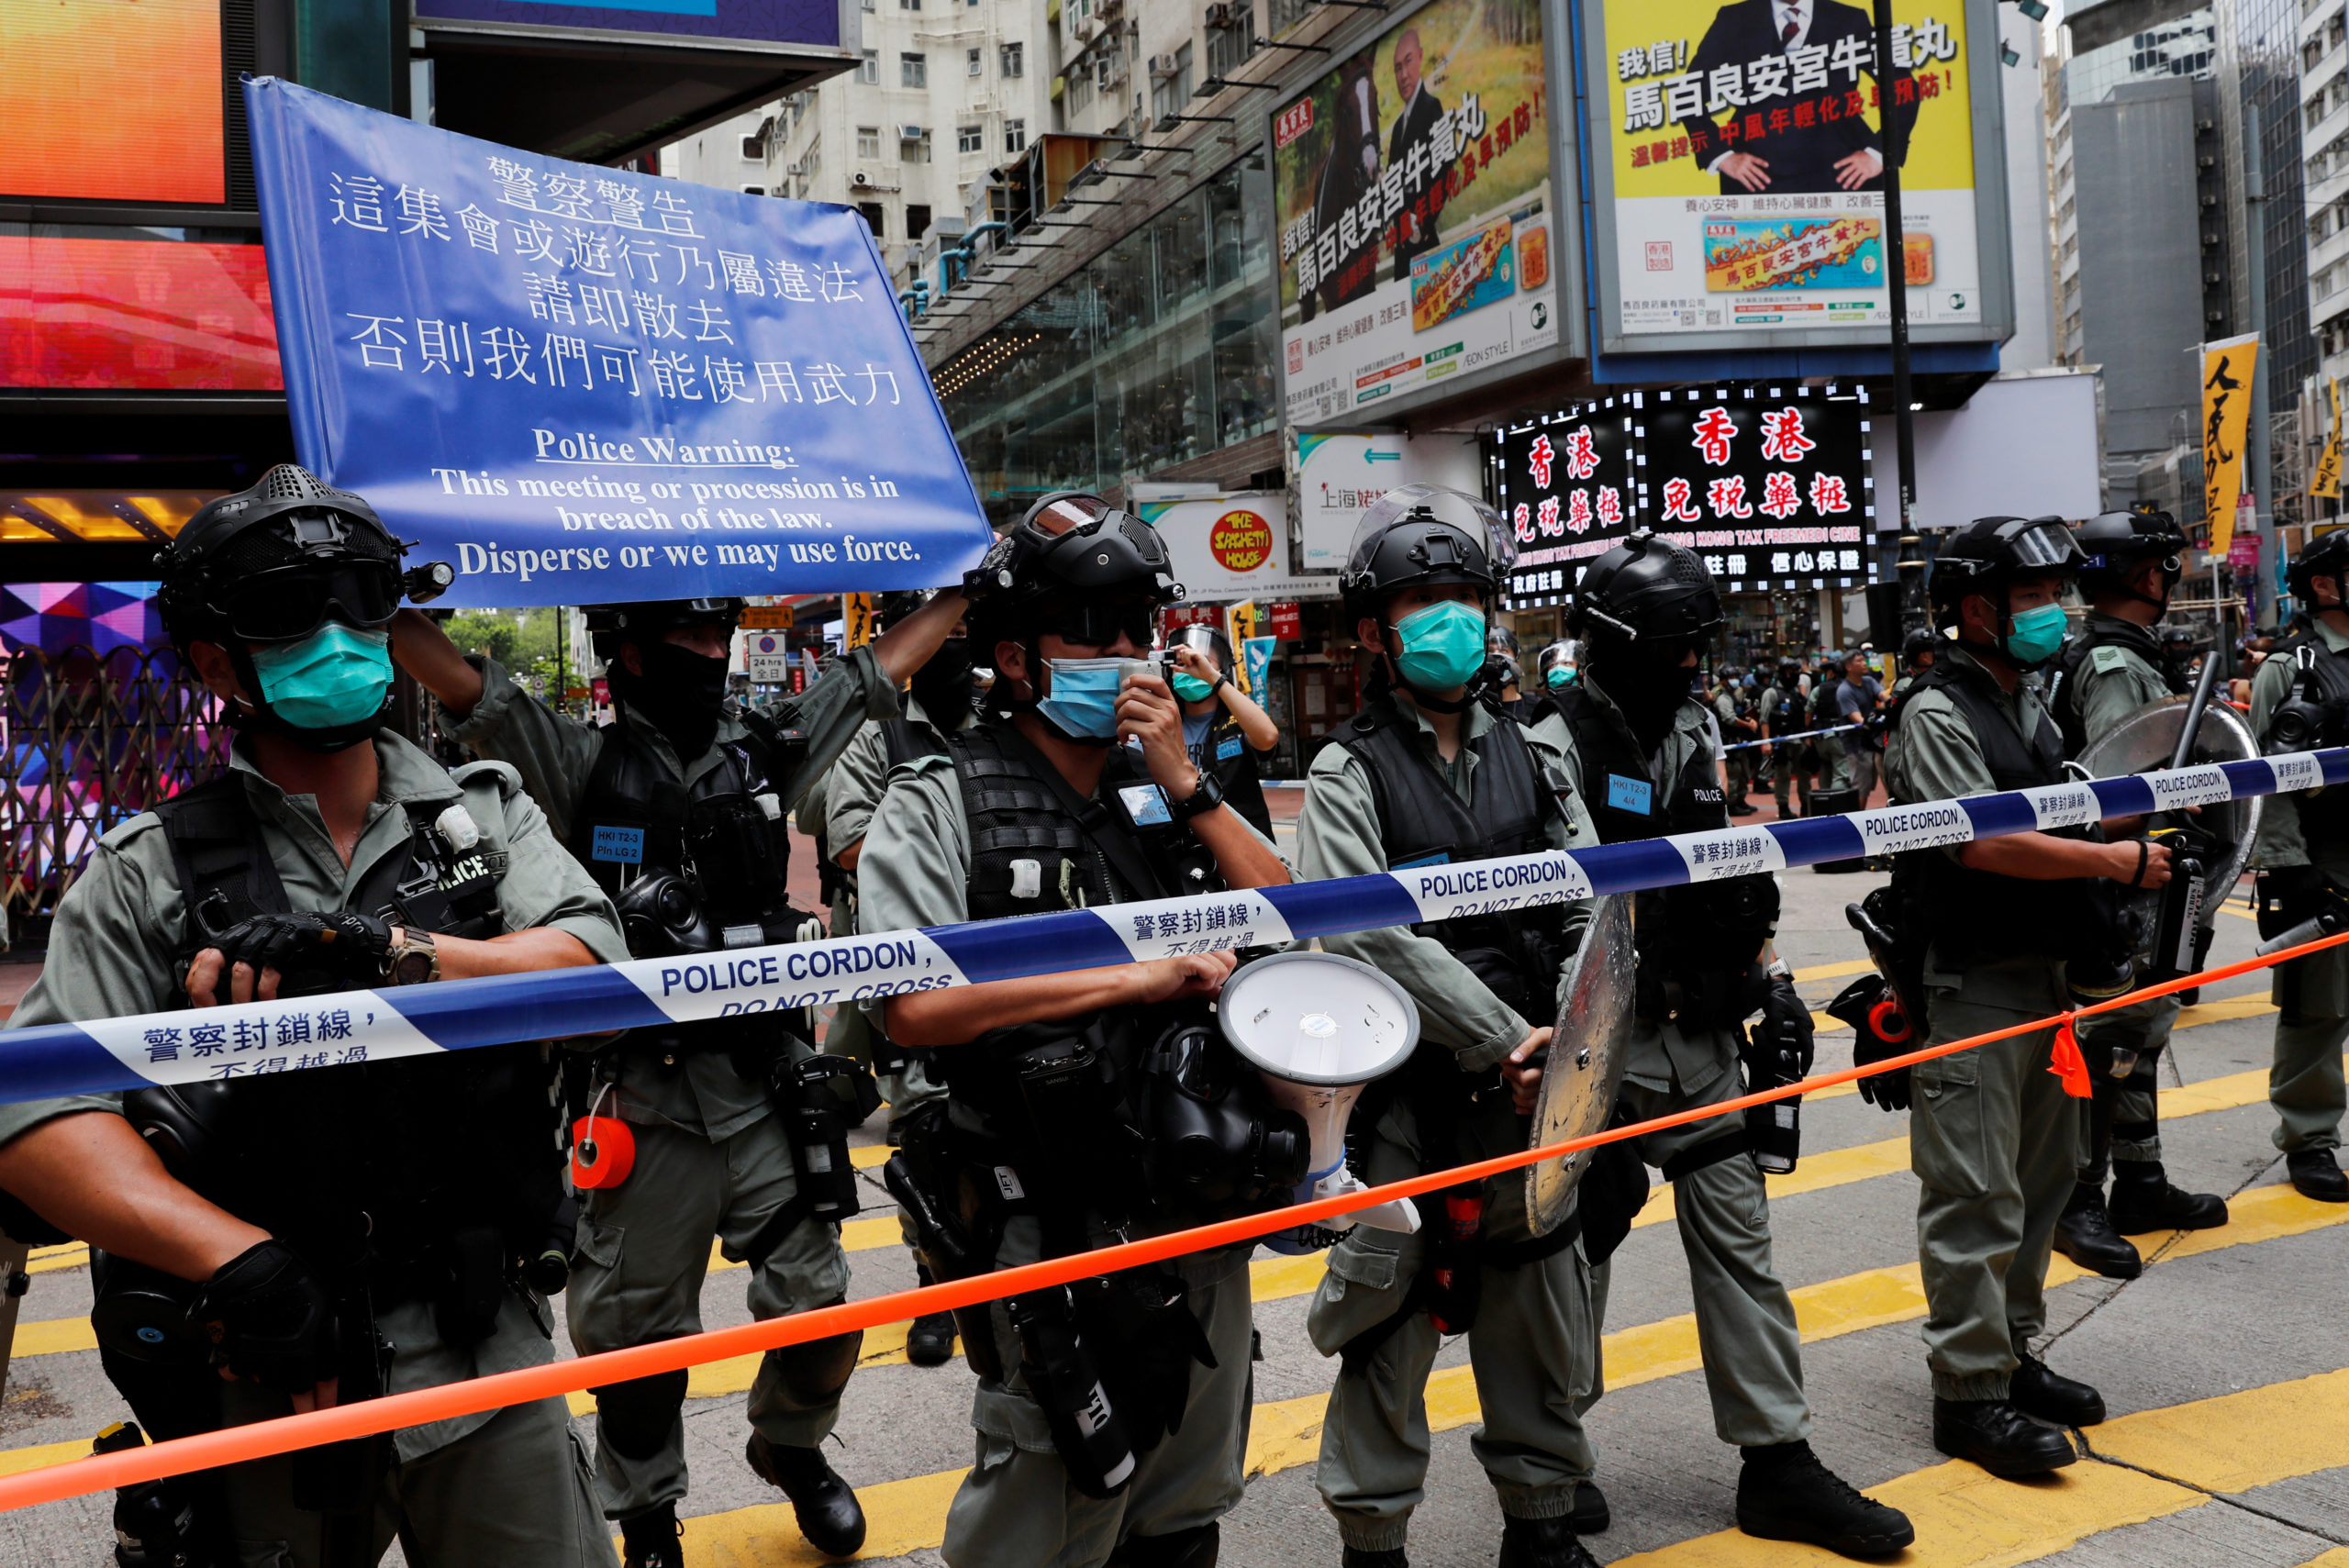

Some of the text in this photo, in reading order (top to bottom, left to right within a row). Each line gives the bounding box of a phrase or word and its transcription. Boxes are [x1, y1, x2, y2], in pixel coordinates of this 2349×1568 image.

[1619, 39, 1687, 79] 我信!
[485, 155, 704, 238] 警察警告
[1686, 195, 1739, 213] 養心安神
[329, 171, 863, 304] 這集會或遊行乃屬違法
[1283, 206, 1316, 261] 我信!
[522, 272, 733, 345] 請即散去
[347, 313, 902, 406] 否則我們可能使用武力
[1485, 340, 1508, 360] STYLE
[1693, 406, 1816, 466] 香港
[531, 428, 796, 469] Police Warning:
[1529, 425, 1600, 489] 香港
[431, 468, 899, 505] This meeting or procession is in
[554, 506, 833, 531] breach of the law.
[1225, 513, 1252, 529] THE
[1697, 530, 1734, 548] KONG
[1736, 529, 1764, 546] TAX
[455, 535, 921, 582] Disperse or we may use force.
[1226, 550, 1262, 568] HOUSE
[1555, 549, 1571, 561] TAX
[1771, 550, 1861, 573] 信心保證
[1513, 570, 1563, 594] 政府註冊
[754, 659, 782, 667] 24 hrs
[1612, 778, 1648, 795] HKI T2-3
[1693, 787, 1722, 803] POLICE
[2155, 776, 2186, 795] POLICE
[1622, 795, 1636, 806] 4/4
[597, 830, 639, 843] HKI T2-3
[1865, 814, 1908, 837] POLICE
[615, 846, 629, 857] LG
[630, 847, 638, 858] 2
[1420, 867, 1487, 899] POLICE
[662, 956, 780, 997] POLICE
[852, 974, 952, 1001] CROSS
